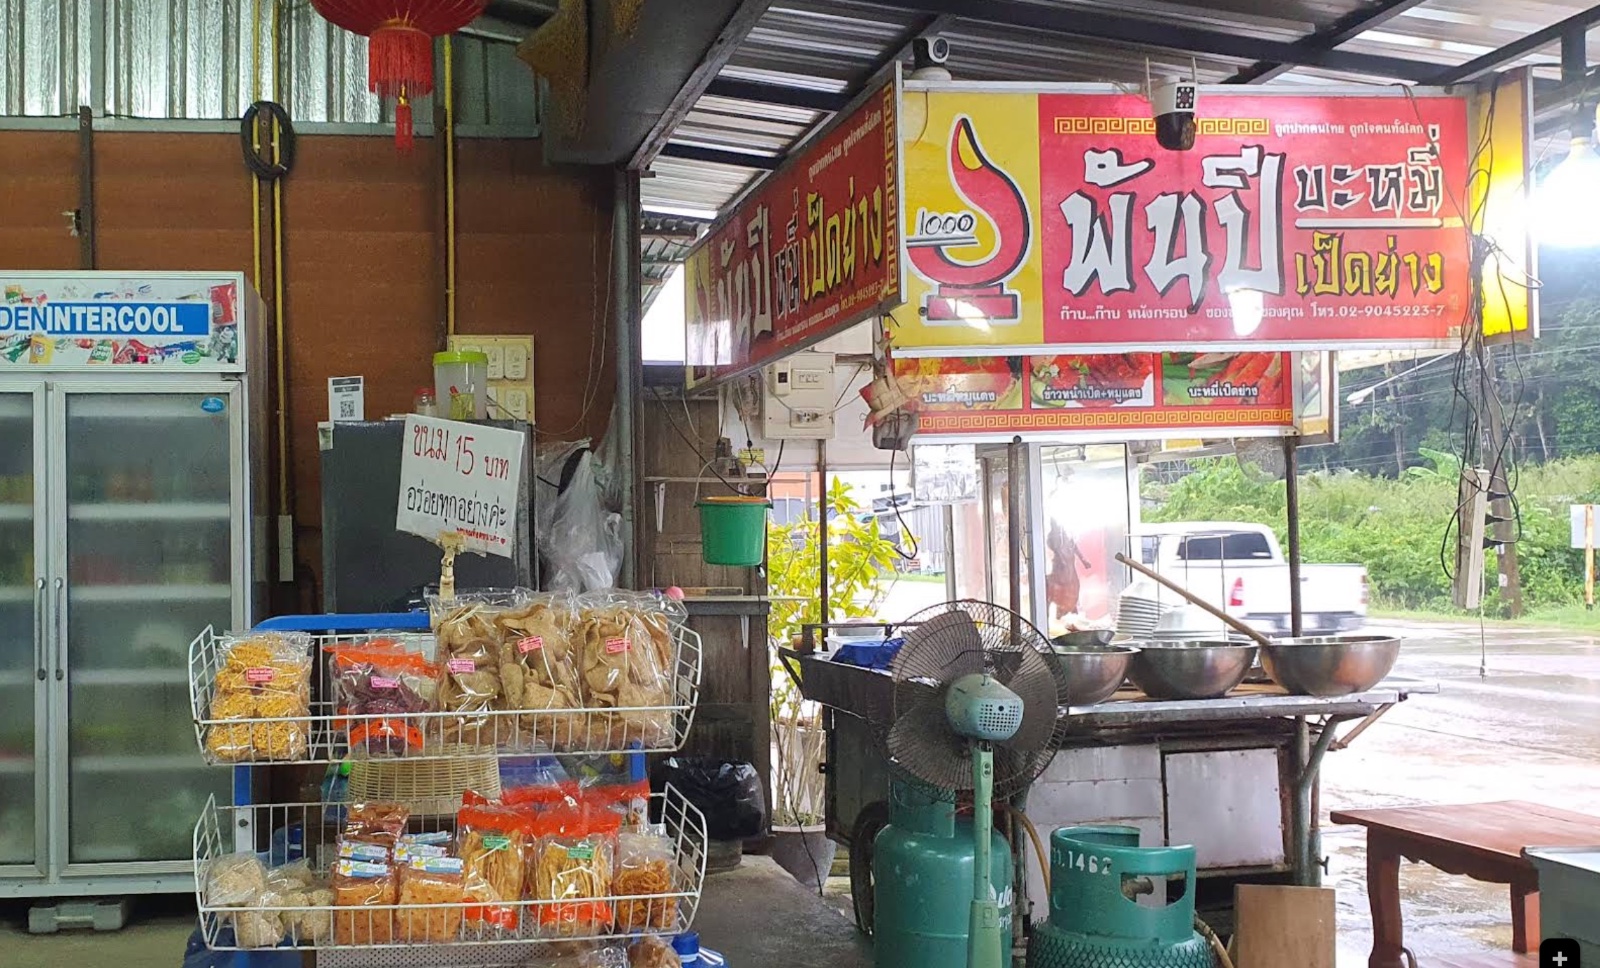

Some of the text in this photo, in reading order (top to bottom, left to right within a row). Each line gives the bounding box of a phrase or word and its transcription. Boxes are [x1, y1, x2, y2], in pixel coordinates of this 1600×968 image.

[1274, 119, 1424, 138] ถูกปากคนไทย ถูกใจคนทั้งโลก
[1293, 124, 1443, 218] บะหมี่
[919, 210, 974, 236] 1000
[1058, 144, 1286, 313] พันปี
[1295, 230, 1444, 300] เป็ดย่าง
[49, 306, 184, 332] INTERCOOL
[1127, 304, 1188, 319] หนังกรอบ
[1310, 301, 1444, 318] โทร.02-9045223-7
[1188, 380, 1259, 397] บะหมี่เป็ดย่าง
[413, 424, 510, 481] ขนม 15 บาท
[407, 479, 507, 527] อร่อยทุกอย่างค่ะ
